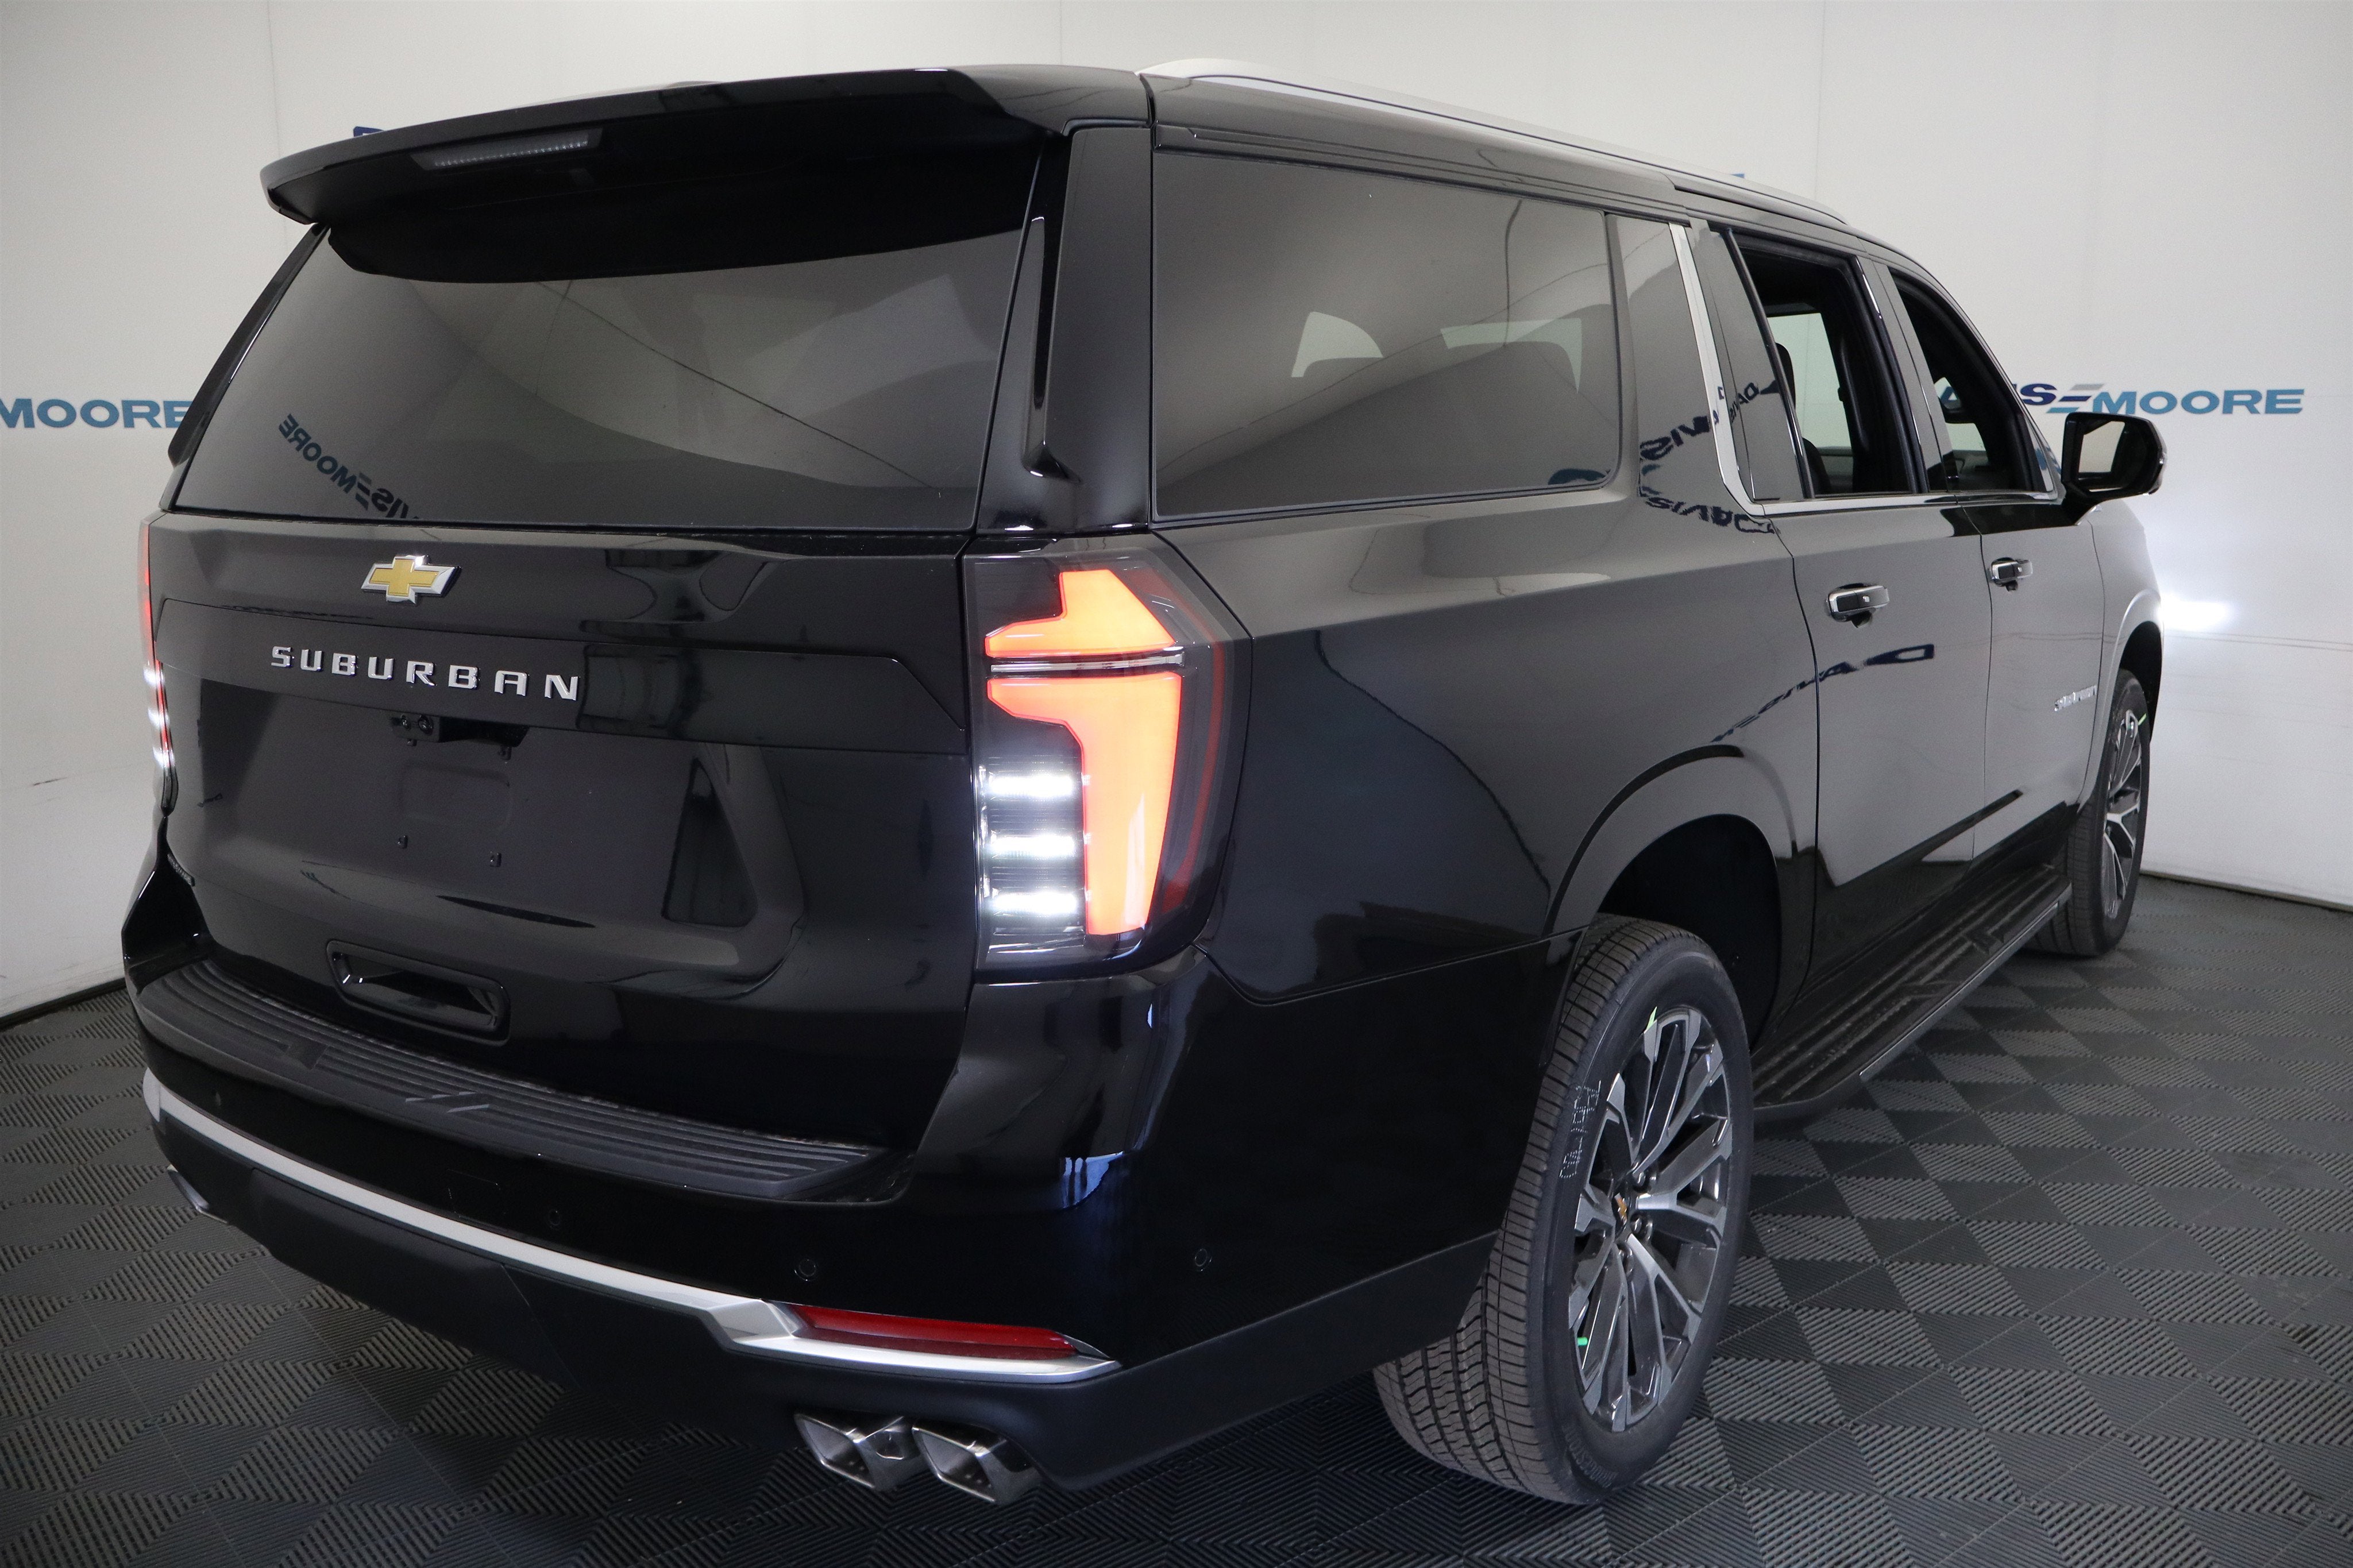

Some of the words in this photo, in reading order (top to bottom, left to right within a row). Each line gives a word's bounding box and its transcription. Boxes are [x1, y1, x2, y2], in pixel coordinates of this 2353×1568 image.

[0, 399, 195, 428] MOORE
[2092, 388, 2305, 415] MOORE
[271, 646, 579, 701] SUBURBAN
